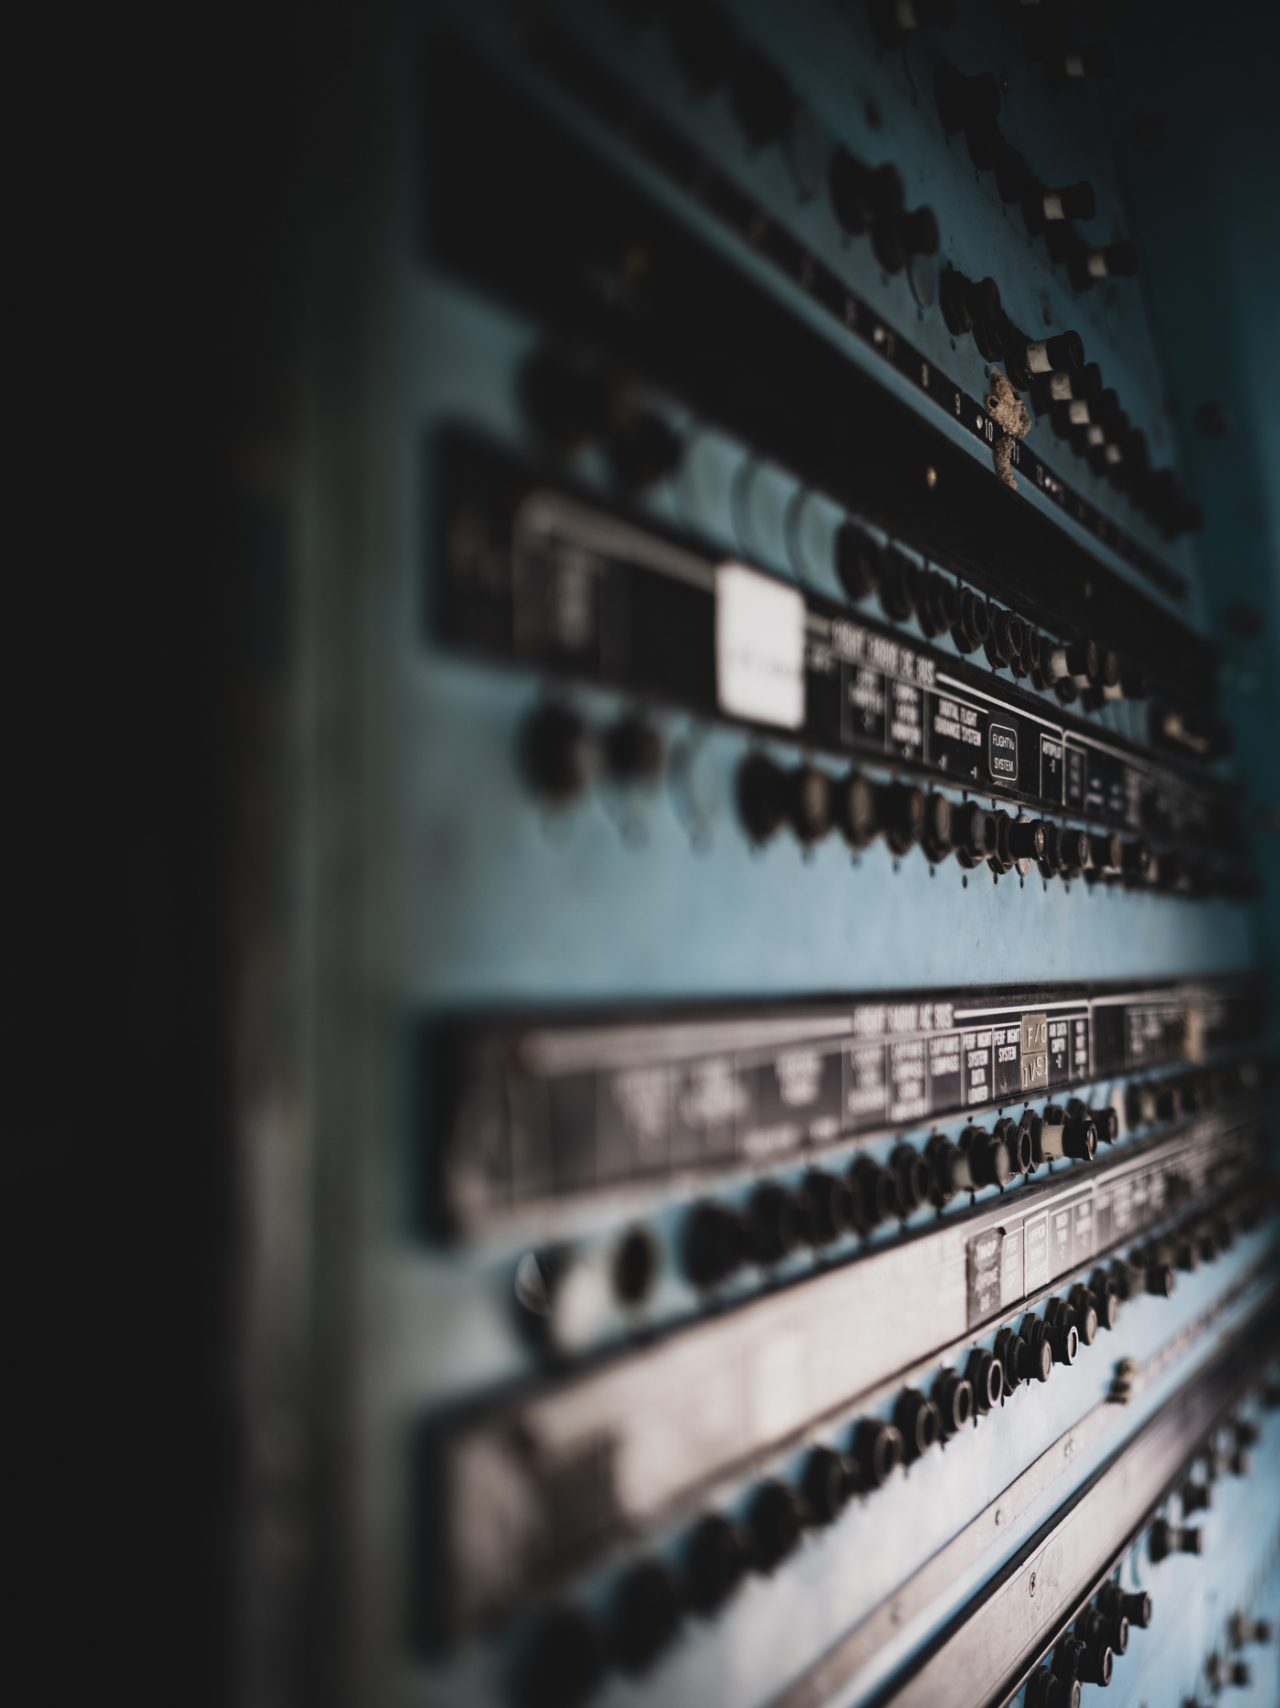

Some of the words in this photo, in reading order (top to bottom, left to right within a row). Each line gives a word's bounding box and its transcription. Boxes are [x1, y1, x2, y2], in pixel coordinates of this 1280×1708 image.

[984, 418, 994, 442] 10
[916, 656, 935, 686] BUS
[961, 725, 982, 747] SYSTEM
[993, 757, 1014, 773] SYSTEM
[934, 1003, 953, 1028] BUS
[994, 1030, 1006, 1046] PERF
[968, 1049, 989, 1069] SYSTEM
[998, 1046, 1017, 1063] SYSTEM
